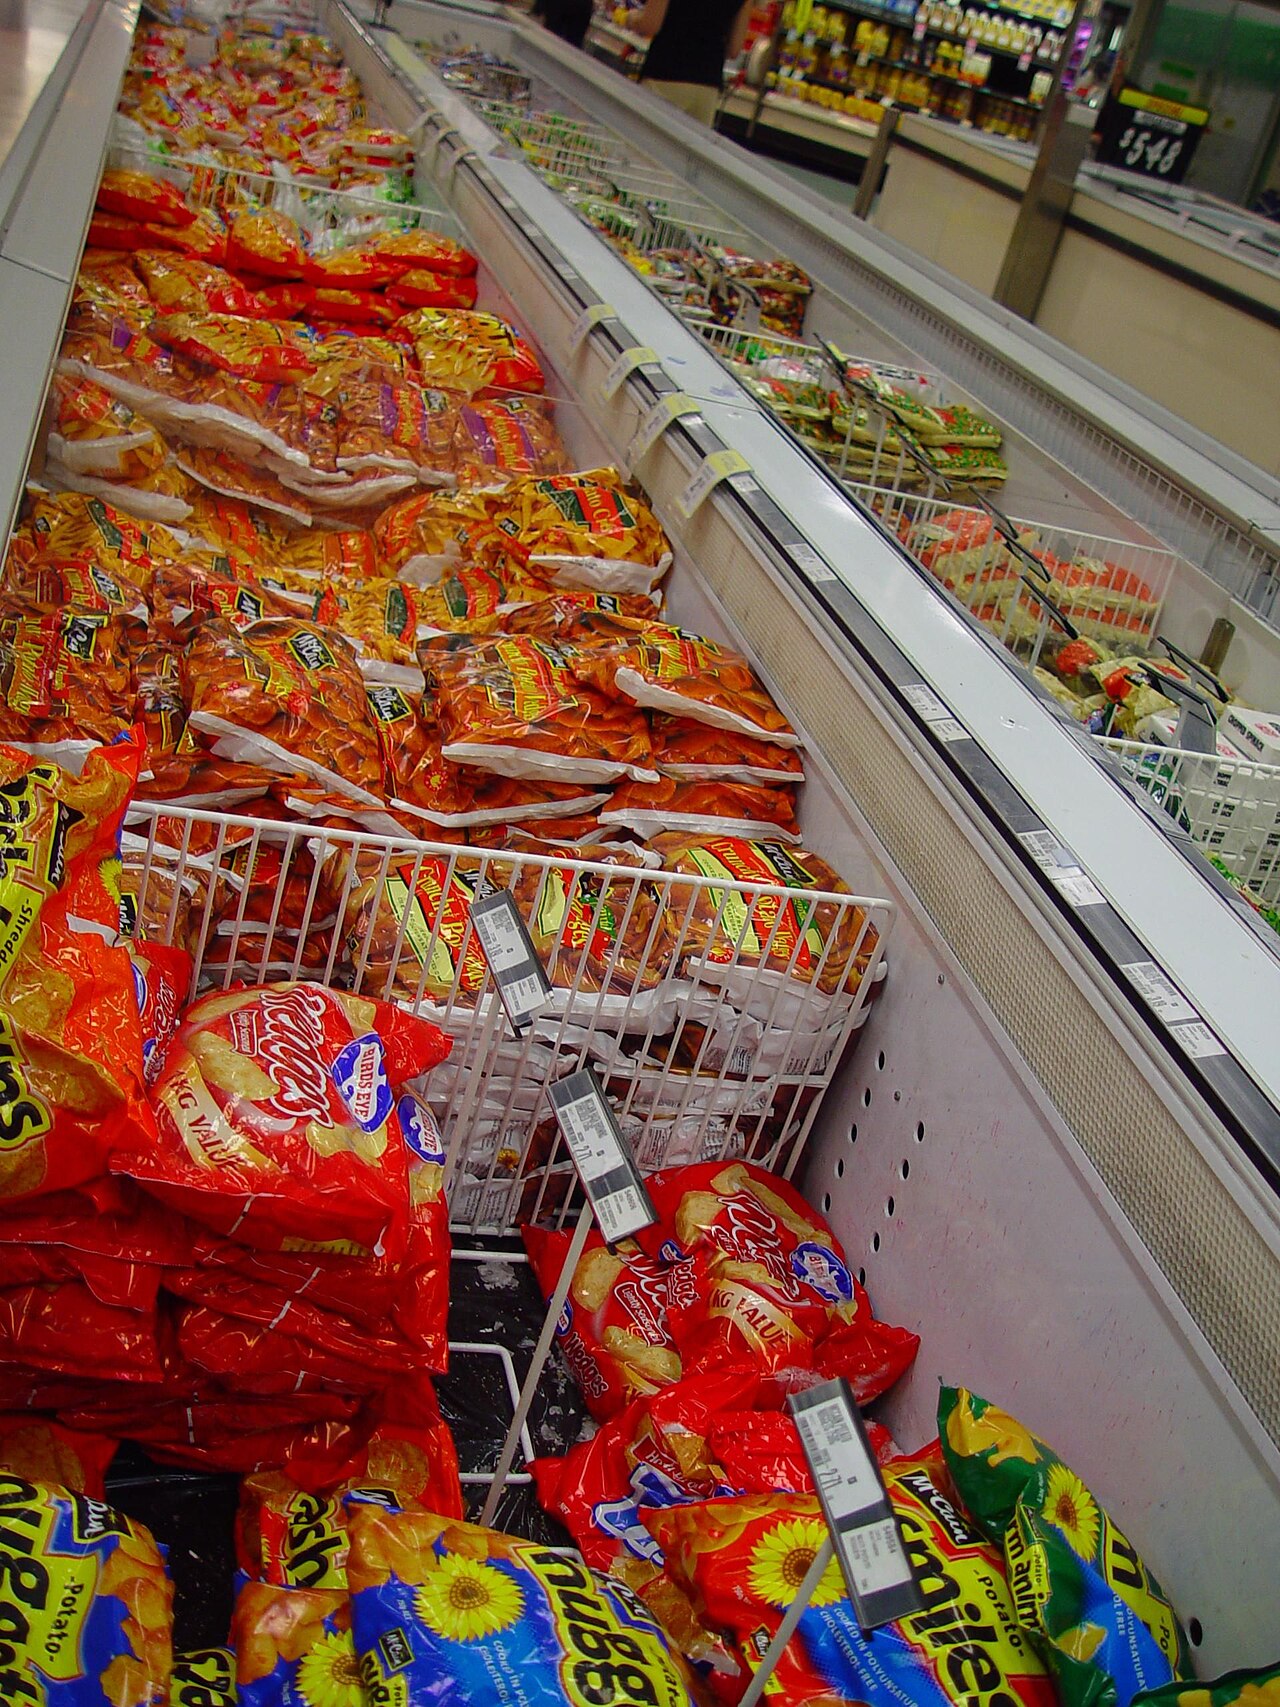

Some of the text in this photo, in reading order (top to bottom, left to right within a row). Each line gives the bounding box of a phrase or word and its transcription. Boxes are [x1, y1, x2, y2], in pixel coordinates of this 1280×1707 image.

[293, 632, 322, 670] McCain
[1228, 714, 1264, 752] CHOPPED SPINACH
[354, 1047, 376, 1120] BIRDS EYE
[564, 1331, 609, 1399] Wedges
[286, 1494, 342, 1588] ash
[902, 1475, 969, 1545] McCain
[530, 1552, 659, 1707] nugg
[819, 1610, 879, 1692] CHOLESTEROL FREE
[834, 1607, 920, 1707] COOKED IN POLYUNSATUR
[1115, 1609, 1126, 1636] FREE
